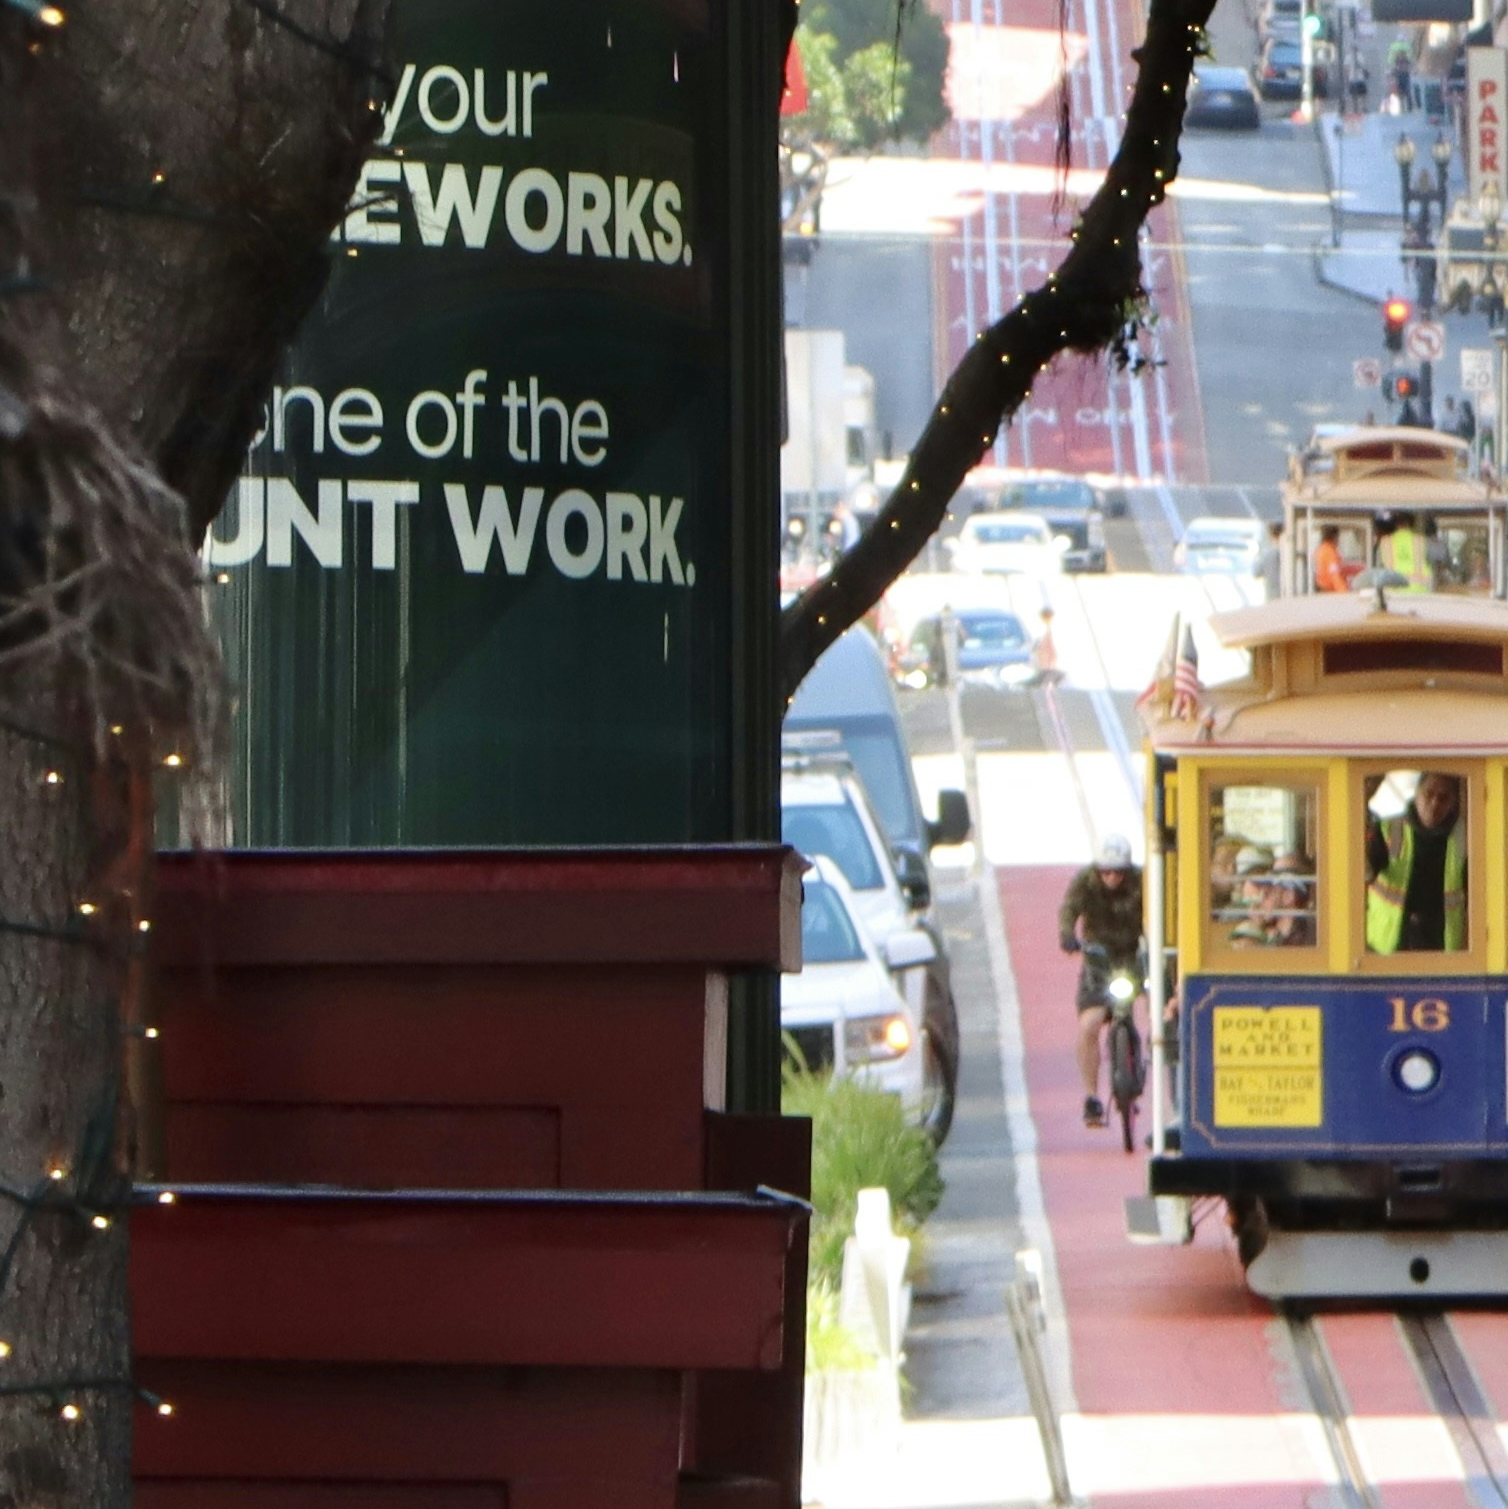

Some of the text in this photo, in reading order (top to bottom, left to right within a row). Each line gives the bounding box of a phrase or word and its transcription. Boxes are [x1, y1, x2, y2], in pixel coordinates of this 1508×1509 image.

[1479, 80, 1499, 173] PARK
[331, 159, 692, 267] EWORKS.
[248, 369, 609, 467] ne of the
[198, 476, 695, 586] UNT WORK.
[1222, 1017, 1315, 1031] POWELL
[1246, 1033, 1291, 1043] AND
[1388, 997, 1451, 1033] 16
[1218, 1044, 1315, 1057] MARKET
